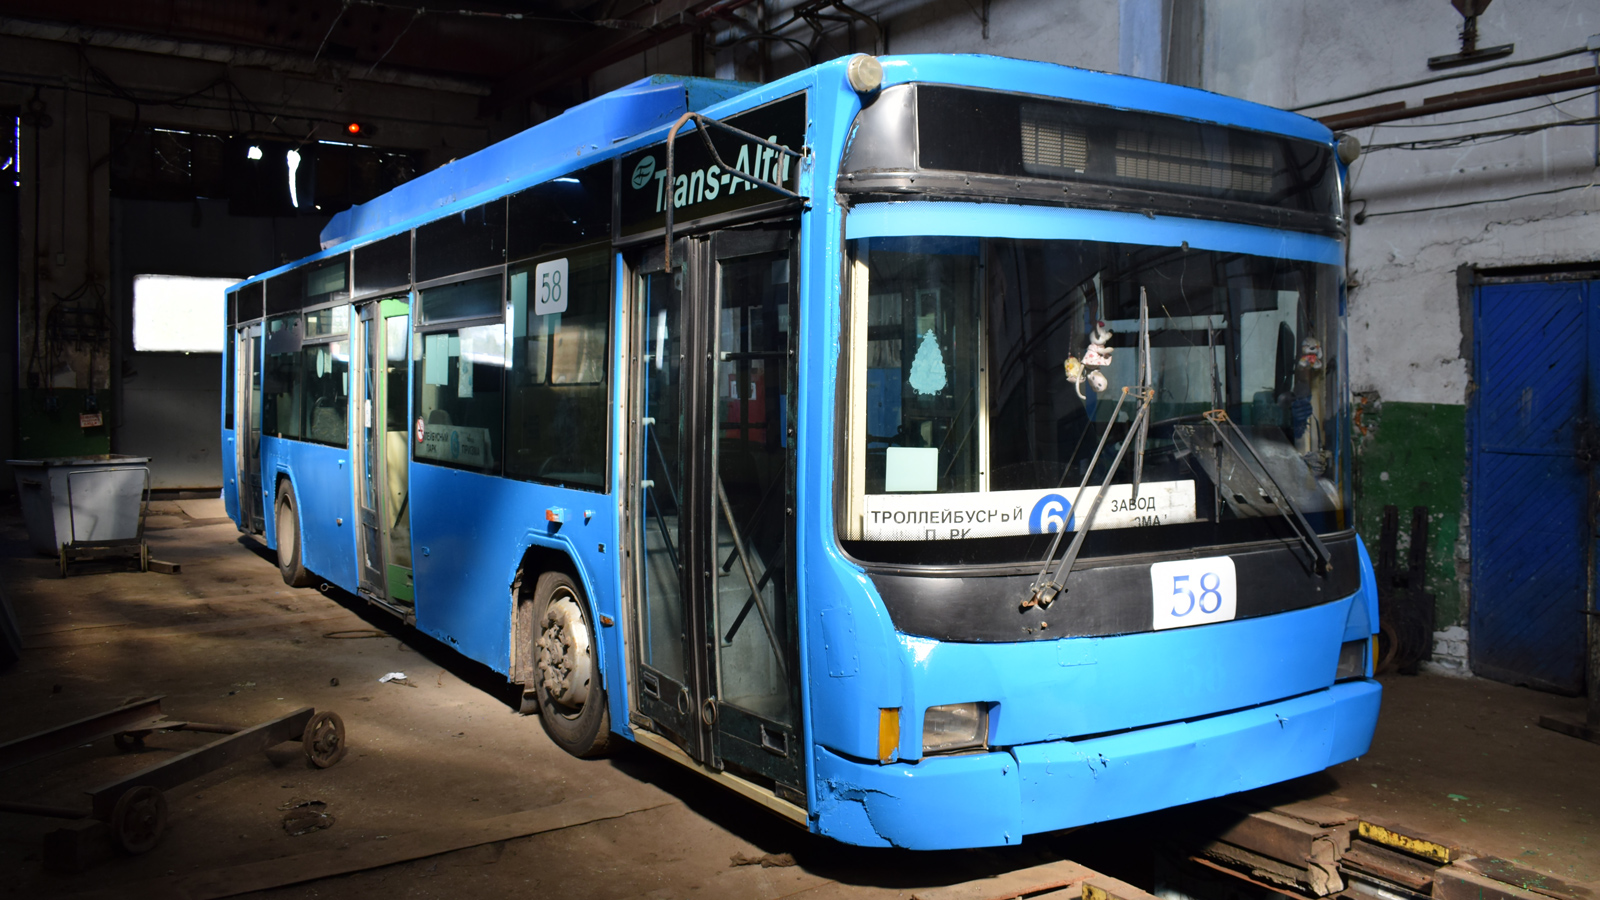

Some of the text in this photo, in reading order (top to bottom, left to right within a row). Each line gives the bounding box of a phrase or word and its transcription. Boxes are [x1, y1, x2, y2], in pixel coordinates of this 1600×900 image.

[541, 270, 562, 304] 58
[1040, 500, 1065, 534] 6
[1111, 496, 1155, 513] ЗАВОД
[925, 528, 972, 540] ПРК
[1171, 572, 1222, 618] 58
